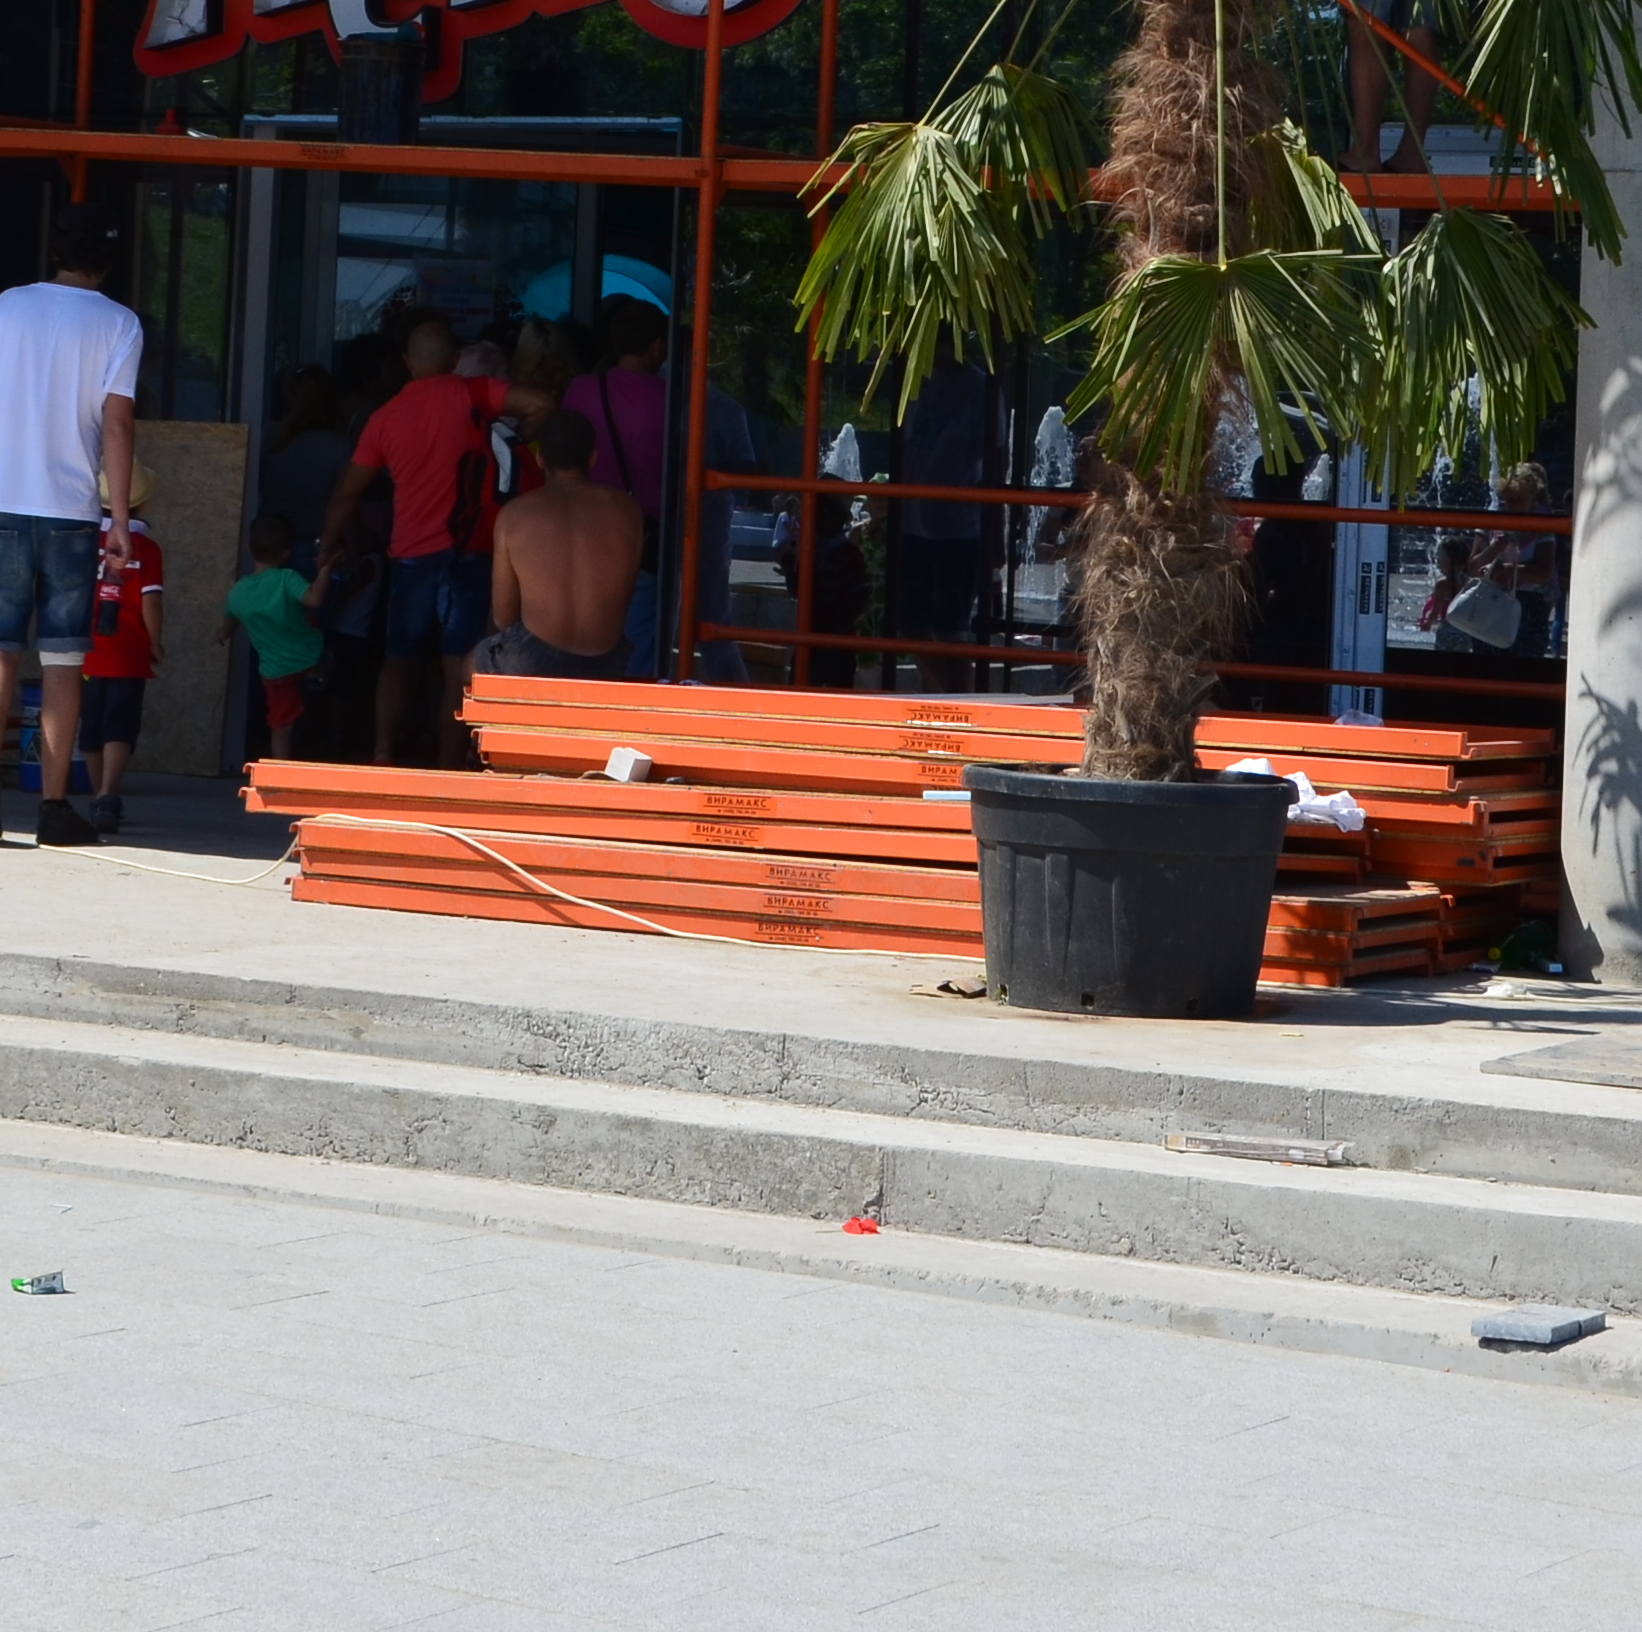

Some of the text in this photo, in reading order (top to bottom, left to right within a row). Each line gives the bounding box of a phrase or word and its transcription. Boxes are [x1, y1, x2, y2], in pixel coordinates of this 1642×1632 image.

[921, 765, 959, 775] ВИРАМ
[707, 796, 767, 808] ВИРАМАКС
[696, 824, 755, 839] ВИРАМАКС
[769, 867, 832, 881] ВИРАМАКС
[767, 897, 830, 910] ВИРАМАКС
[758, 922, 820, 936] ВИРАМАКС
